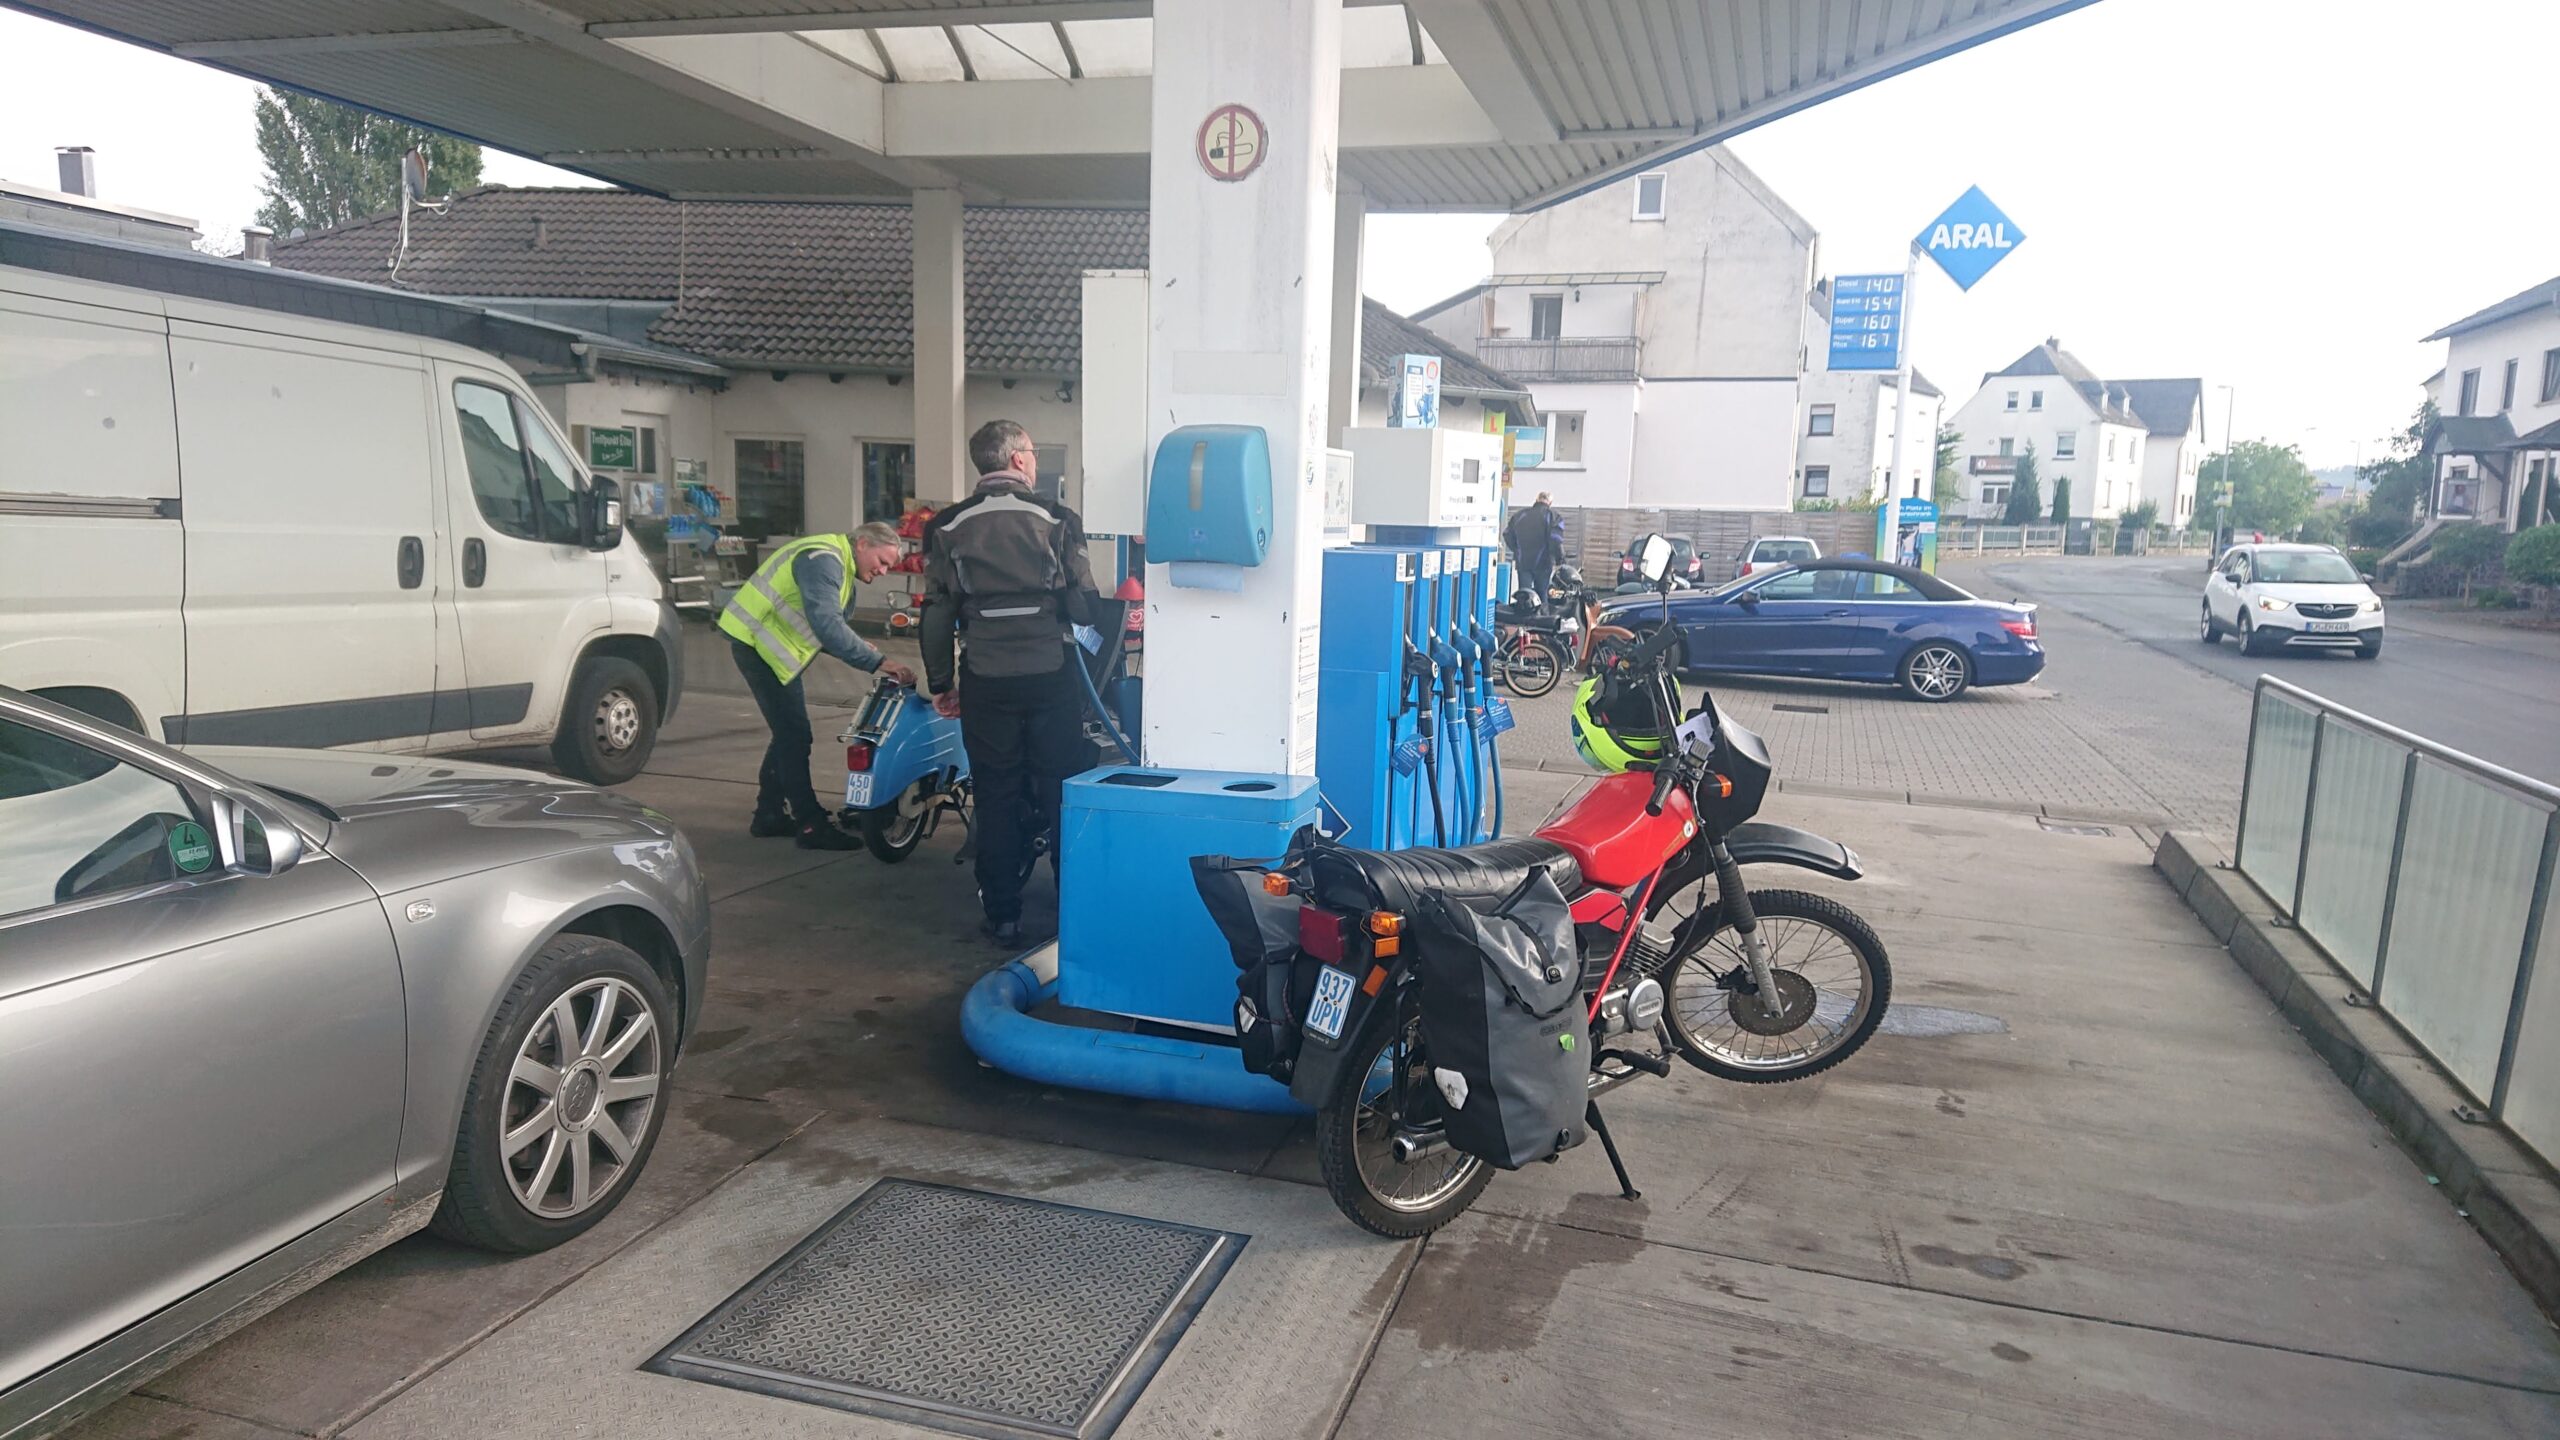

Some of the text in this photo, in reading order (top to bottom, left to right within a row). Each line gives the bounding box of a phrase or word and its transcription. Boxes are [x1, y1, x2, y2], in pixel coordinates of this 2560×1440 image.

[1929, 223, 2012, 249] ARAL
[1866, 278, 1894, 293] 140
[1865, 296, 1893, 311] 154
[1835, 314, 1891, 330] Super 160
[1861, 333, 1889, 348] 167
[1491, 471, 1496, 503] 1
[850, 774, 870, 789] 450
[183, 825, 196, 847] 4
[1320, 971, 1350, 1003] 937
[1311, 999, 1342, 1033] UPN
